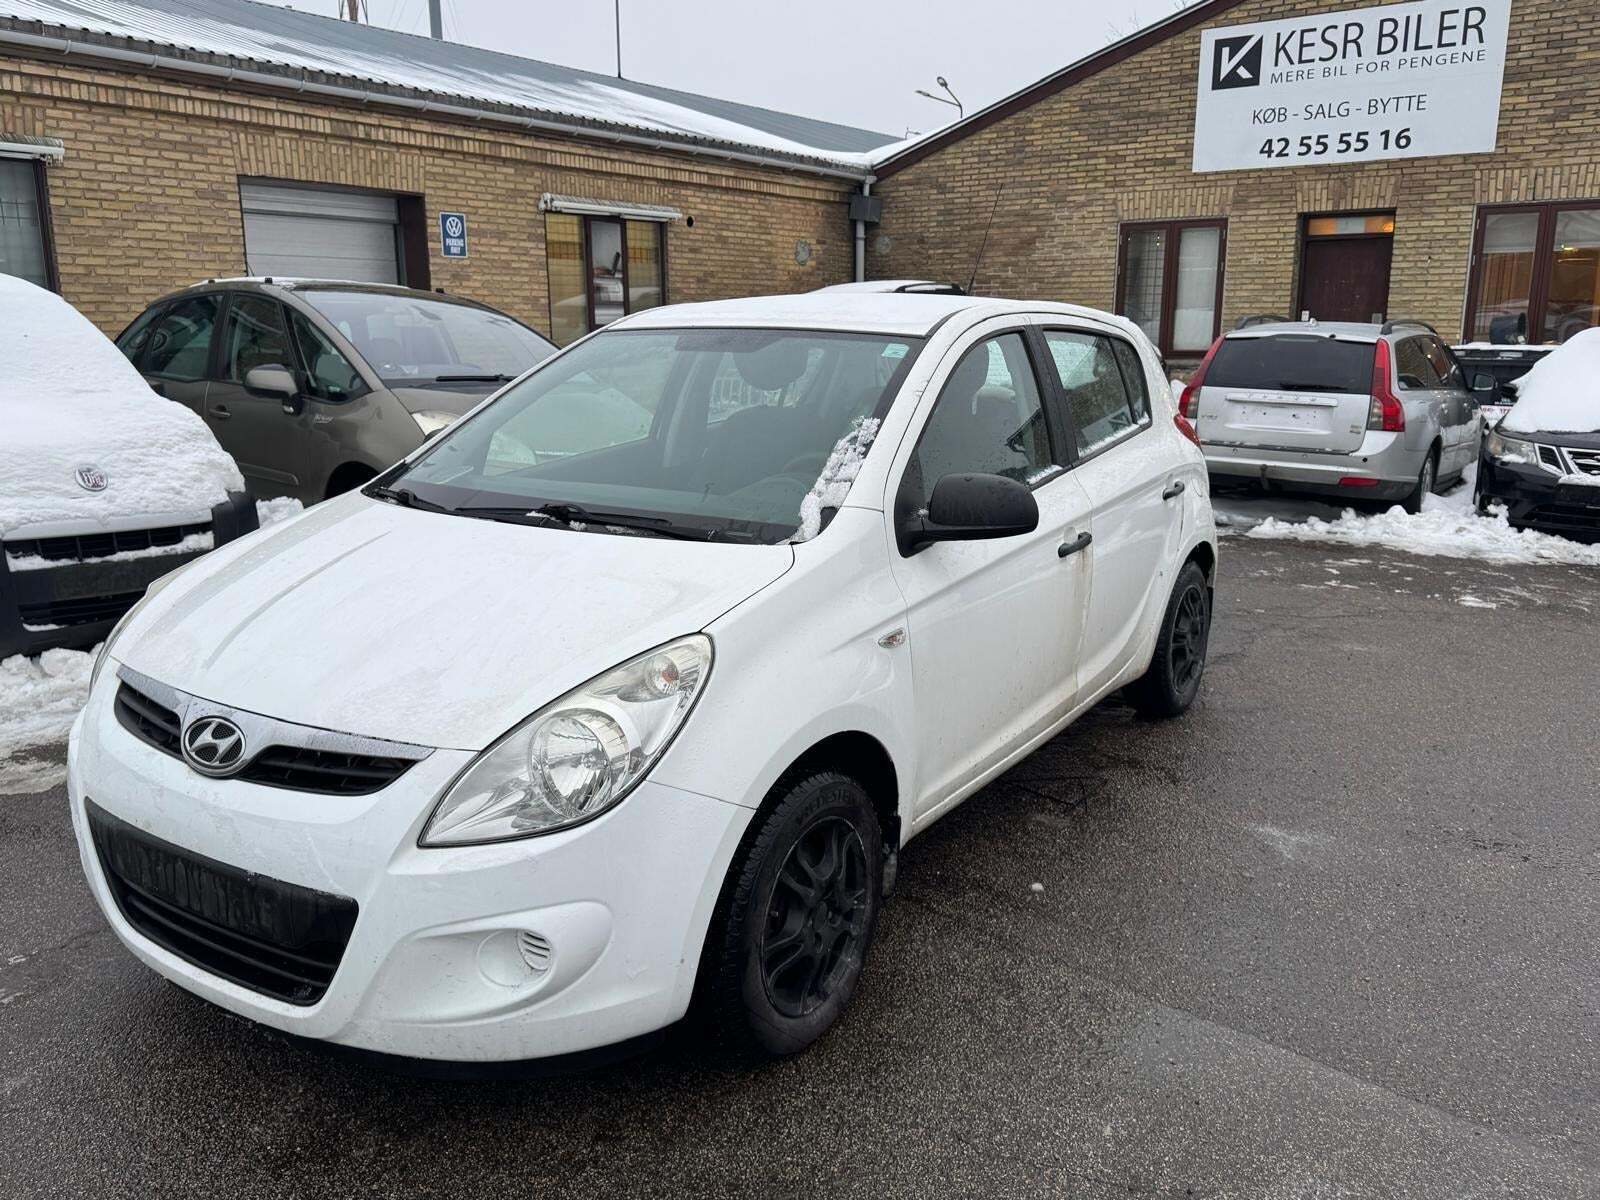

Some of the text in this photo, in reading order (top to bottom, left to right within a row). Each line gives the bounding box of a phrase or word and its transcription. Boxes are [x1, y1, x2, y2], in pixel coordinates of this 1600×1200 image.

[1274, 6, 1486, 67] KESR BILER
[1270, 49, 1486, 84] MERE BIL FOR PENGENE
[1252, 106, 1288, 125] KØB
[1303, 101, 1350, 121] SALG
[1367, 94, 1427, 115] BYTTE
[1259, 127, 1412, 158] 42 55 55 16
